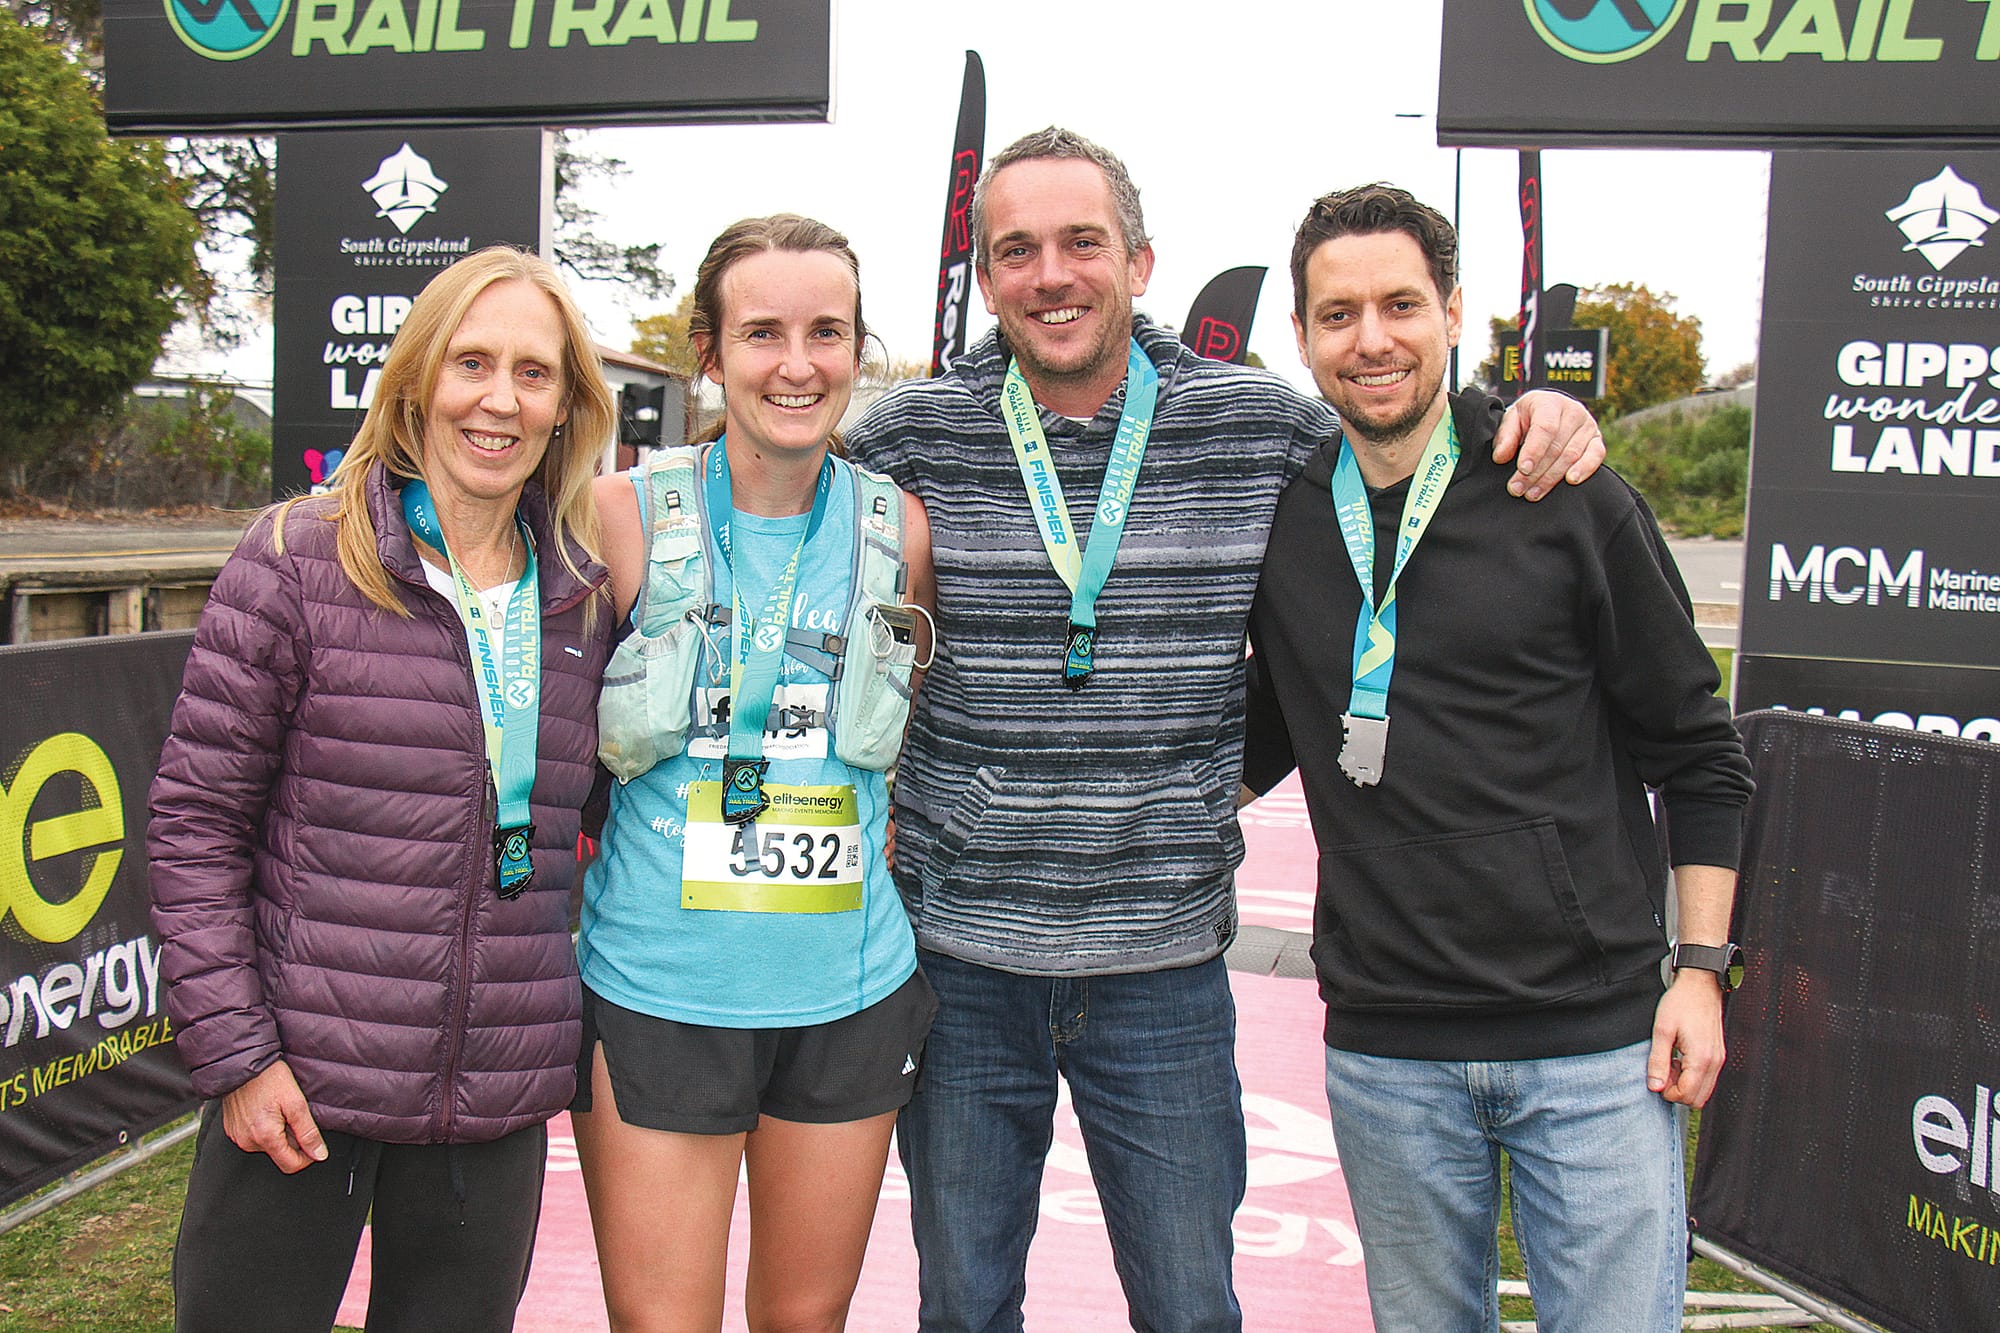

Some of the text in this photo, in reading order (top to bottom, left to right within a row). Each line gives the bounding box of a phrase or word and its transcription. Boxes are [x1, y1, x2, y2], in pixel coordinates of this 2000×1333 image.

[292, 0, 485, 57] RAIL
[1685, 0, 1944, 62] RAIL
[340, 236, 472, 257] South Gippsland
[353, 256, 393, 267] Shire
[1852, 274, 1912, 293] South
[1869, 296, 2000, 310] Shire Counci
[331, 295, 421, 335] GIP
[1104, 414, 1137, 499] SOUTHERN
[1115, 418, 1149, 503] RAIL TRAIL
[413, 505, 430, 535] 2025
[1029, 459, 1067, 546] FINISHER
[1353, 495, 1373, 545] TRAIL
[1339, 504, 1372, 584] SOUTHERN
[1769, 543, 2000, 608] MCM Marine
[521, 580, 536, 680] RAIL TRAIL
[772, 585, 796, 625] RAIL
[506, 590, 522, 679] SOUTHERN
[729, 831, 842, 880] 5532
[32, 1015, 174, 1098] MEMORABLE
